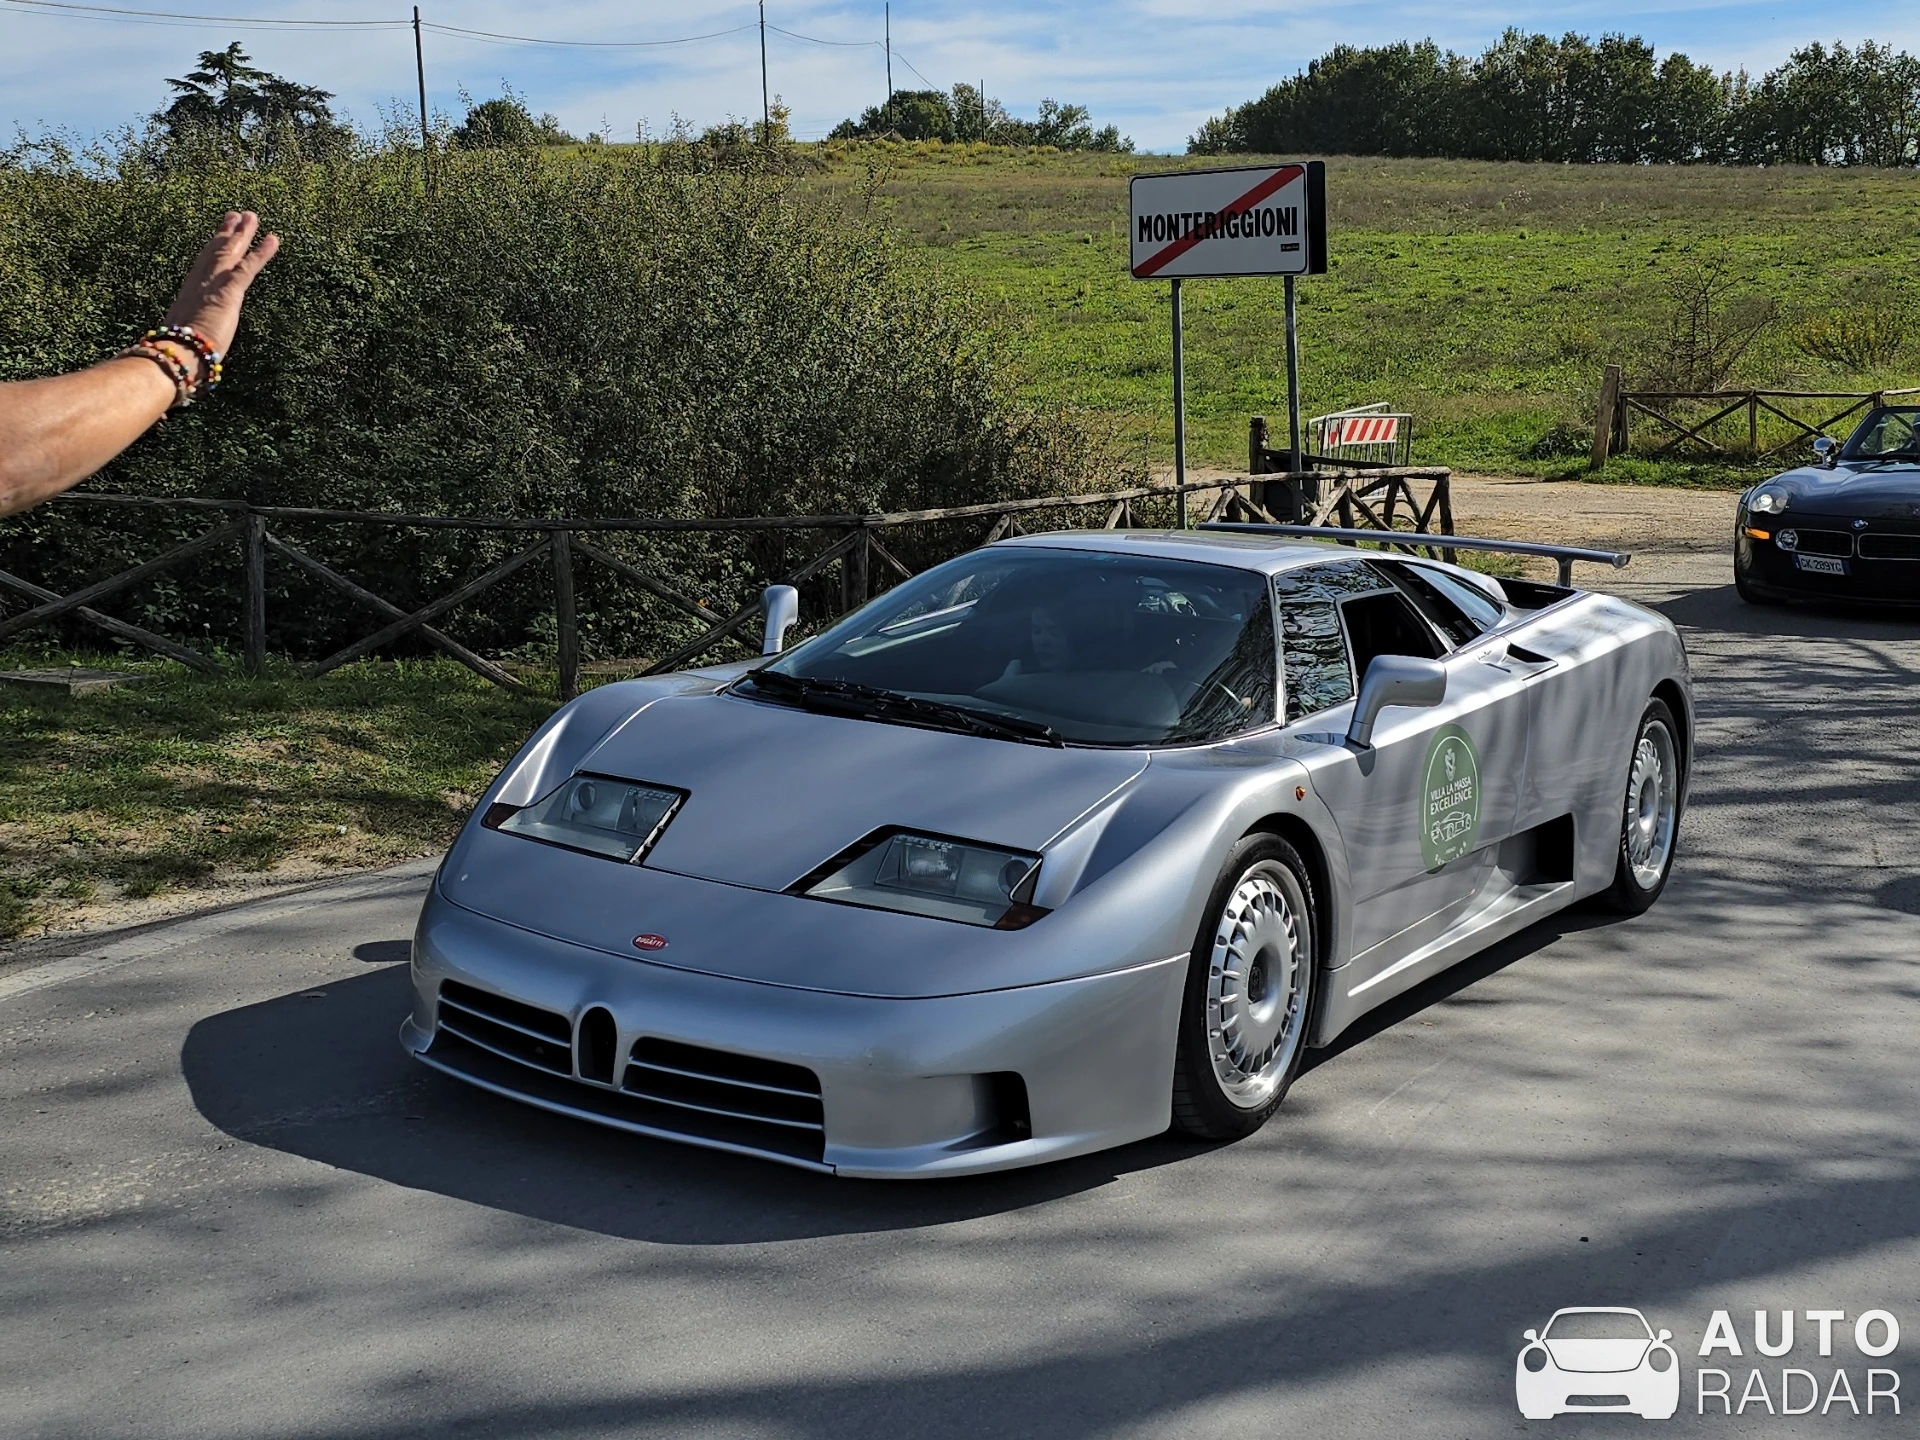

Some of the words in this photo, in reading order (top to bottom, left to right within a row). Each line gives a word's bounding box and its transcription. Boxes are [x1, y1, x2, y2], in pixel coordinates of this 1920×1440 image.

[1138, 206, 1298, 243] MONTERIGGIONI
[1430, 786, 1446, 801] VILLA
[1446, 783, 1454, 795] LA
[1454, 775, 1473, 791] MASSA
[1430, 786, 1473, 816] EXCELLENCE
